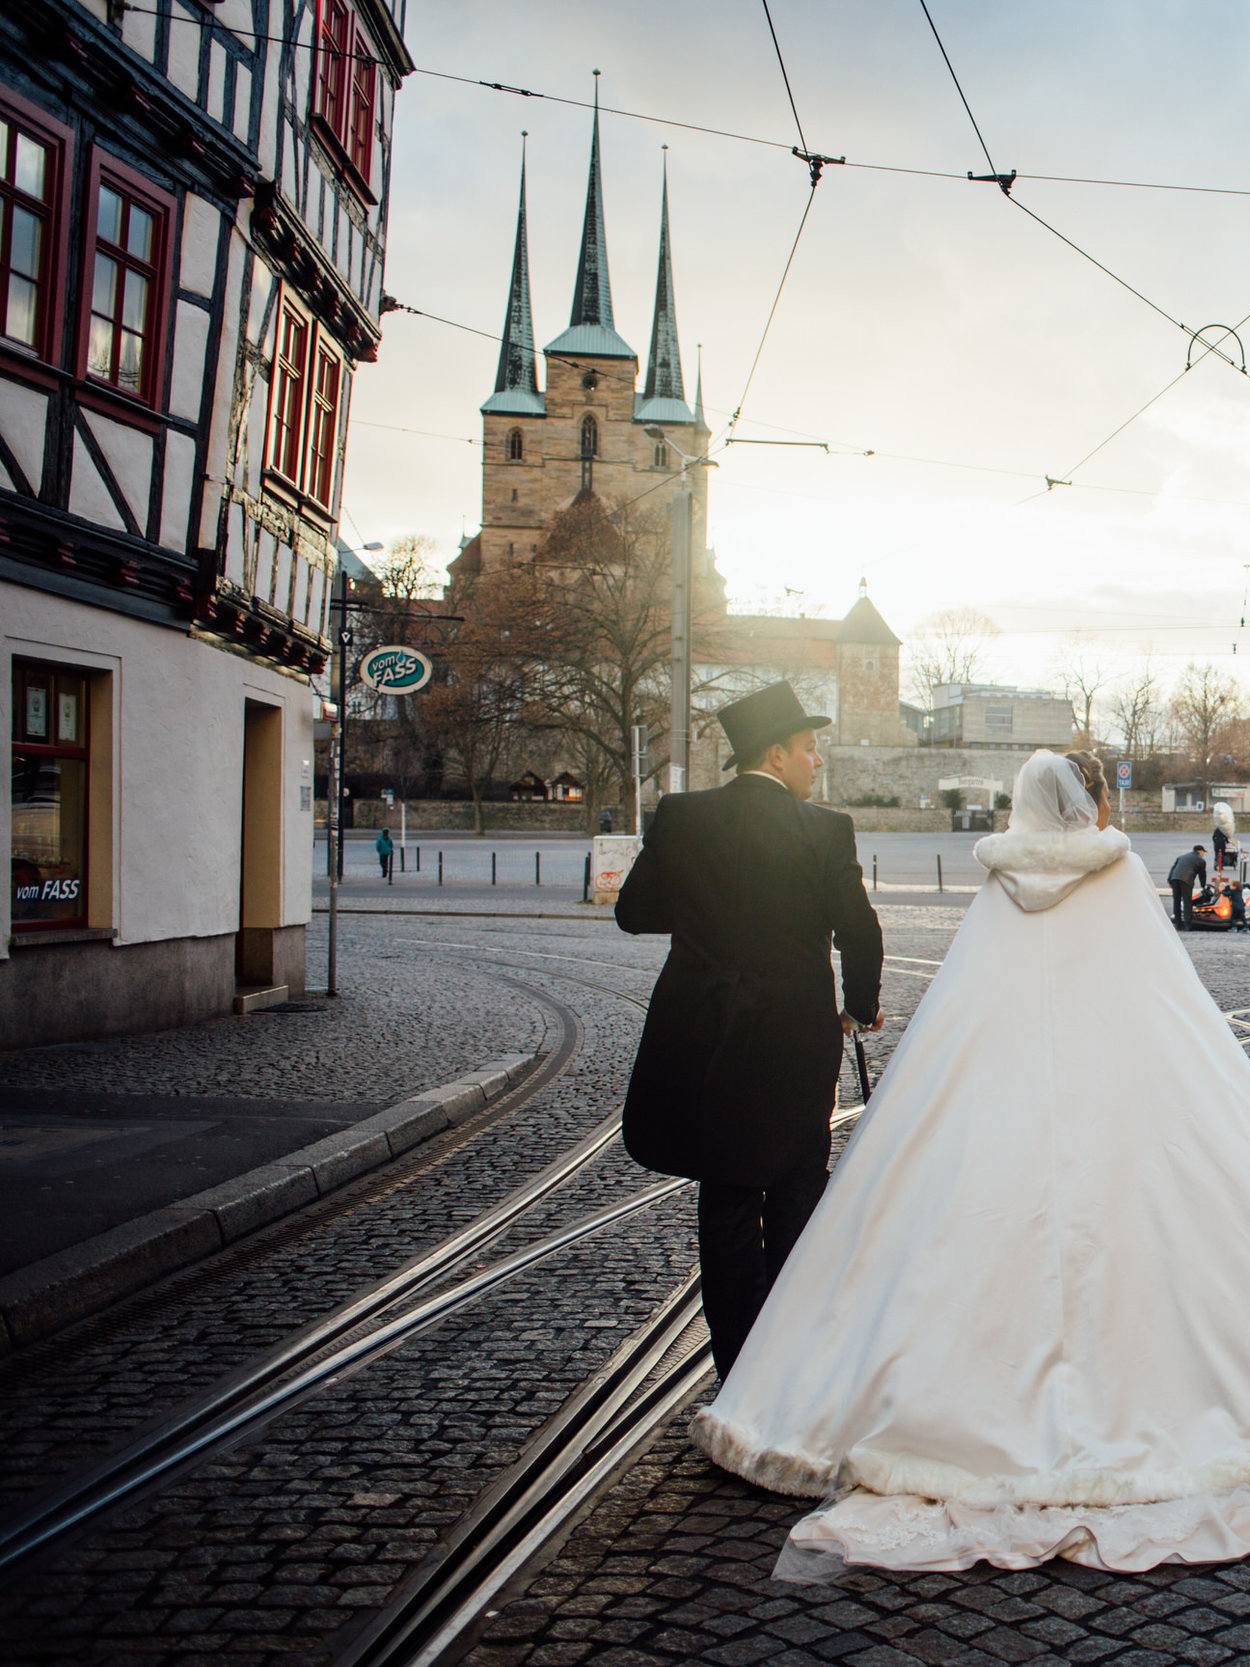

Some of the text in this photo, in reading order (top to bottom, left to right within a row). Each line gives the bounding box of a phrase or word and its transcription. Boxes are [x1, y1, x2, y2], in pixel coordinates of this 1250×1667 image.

[372, 655, 396, 671] vom
[373, 657, 417, 689] FASS
[17, 879, 80, 900] vom FASS
